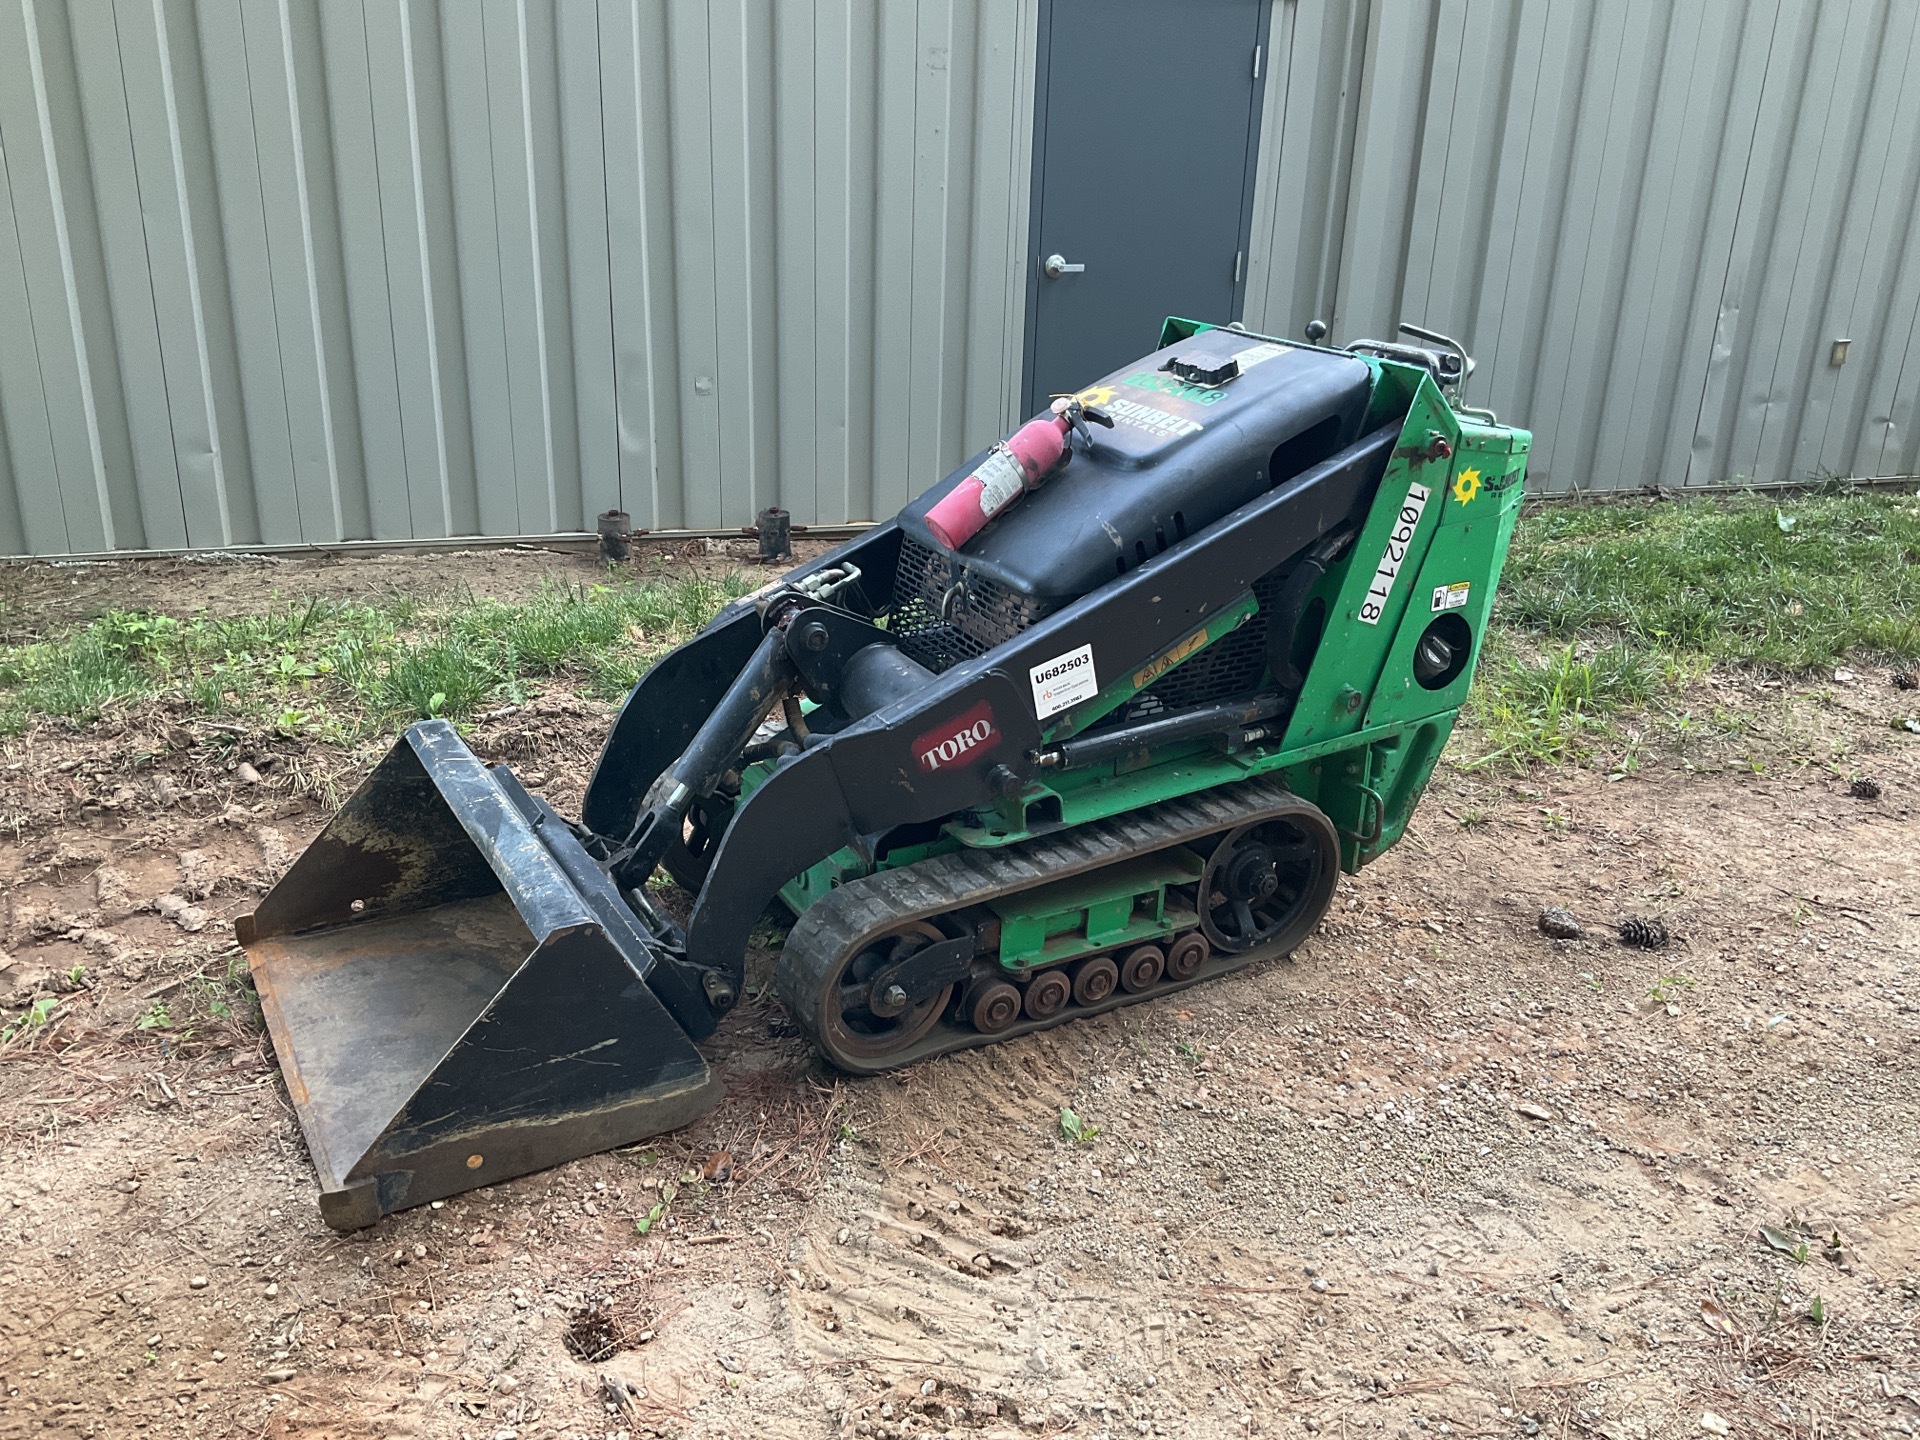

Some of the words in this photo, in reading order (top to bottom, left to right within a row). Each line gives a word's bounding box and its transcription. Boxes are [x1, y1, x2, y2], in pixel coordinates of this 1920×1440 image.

[1104, 398, 1204, 437] SUNBELT
[1360, 490, 1426, 620] 1092118
[1035, 653, 1090, 684] U682503
[921, 719, 991, 771] TORO
